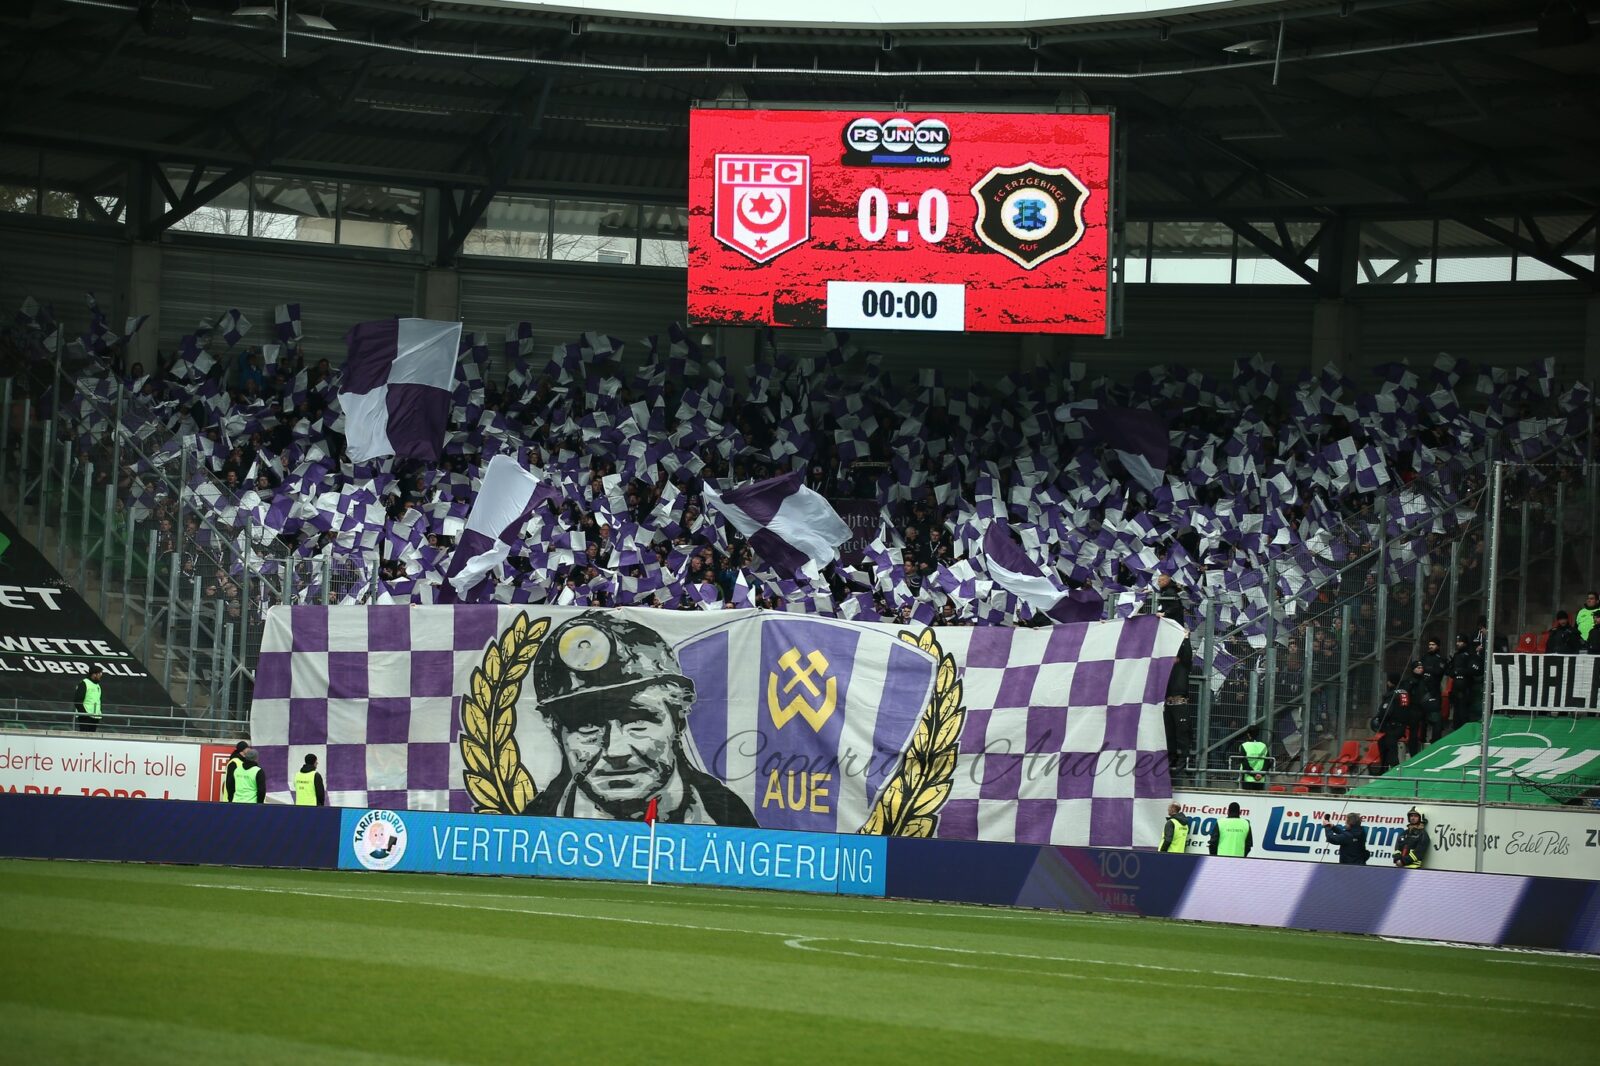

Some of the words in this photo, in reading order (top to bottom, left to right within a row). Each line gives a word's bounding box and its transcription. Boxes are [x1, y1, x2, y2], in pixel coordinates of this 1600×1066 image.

[853, 129, 878, 142] PS
[883, 130, 944, 143] UNION
[726, 162, 798, 183] HFC
[915, 156, 950, 164] GROUP
[857, 187, 950, 243] 0:0
[861, 289, 938, 320] 00:00
[62, 752, 136, 775] wirklich
[144, 755, 187, 778] tolle
[761, 768, 833, 814] AUE
[355, 811, 404, 842] TARIFEGURU
[432, 825, 874, 884] VERTRAGSVERLÄNGERUNG
[1314, 847, 1331, 855] an
[1505, 830, 1542, 855] Edel
[1537, 830, 1571, 856] Pils
[1097, 851, 1141, 879] 100
